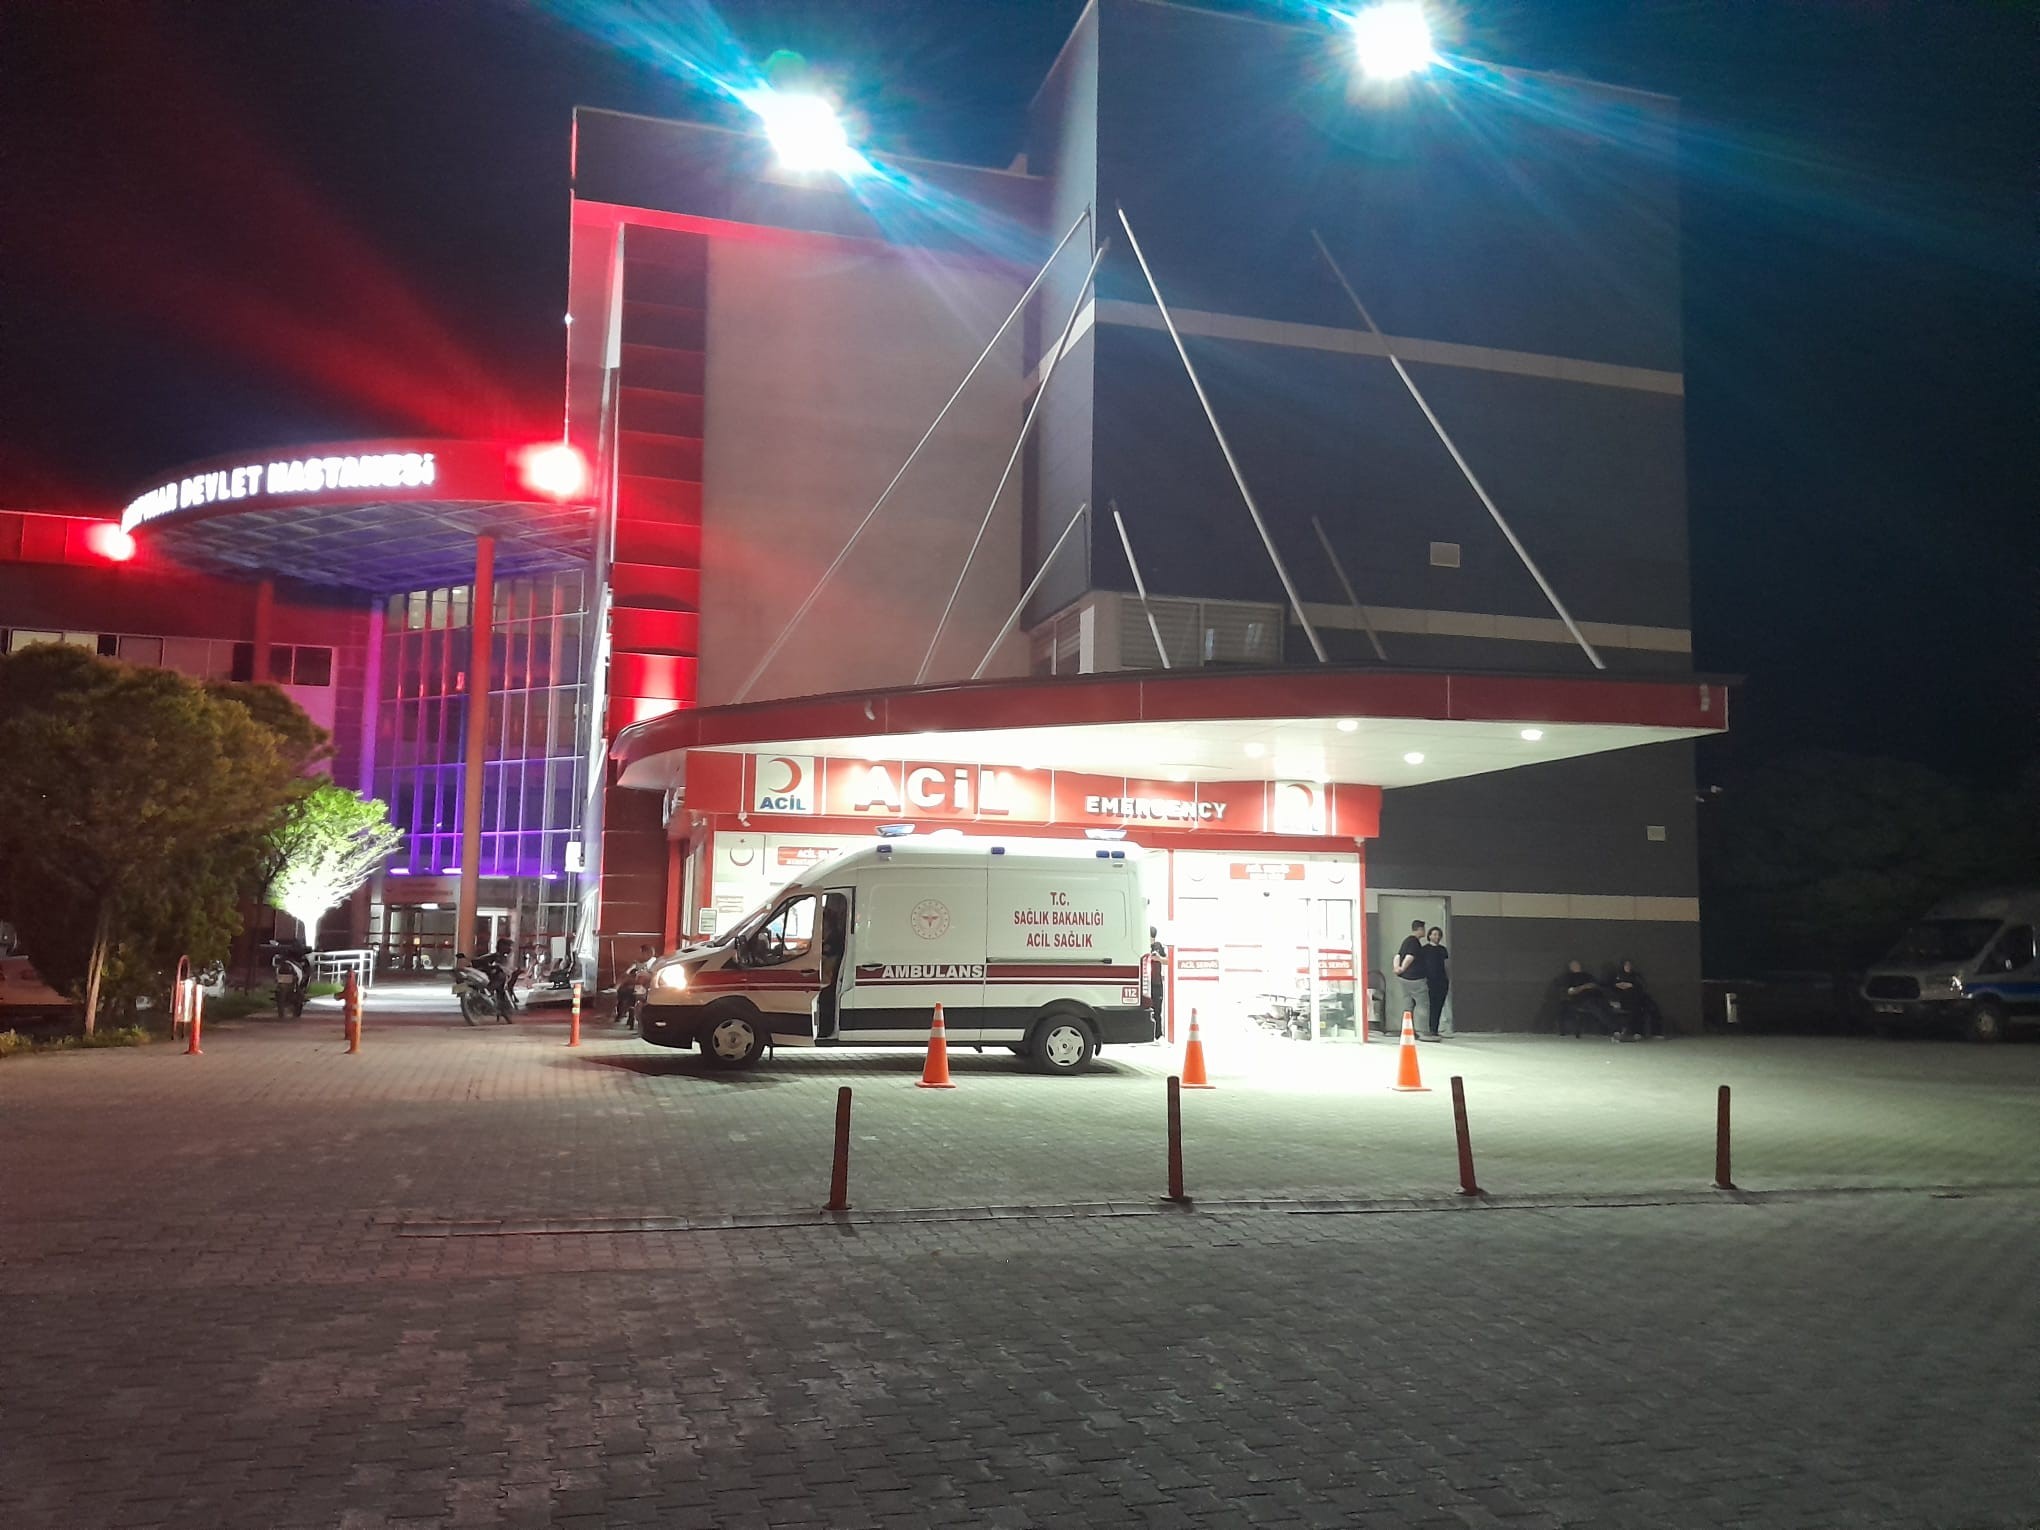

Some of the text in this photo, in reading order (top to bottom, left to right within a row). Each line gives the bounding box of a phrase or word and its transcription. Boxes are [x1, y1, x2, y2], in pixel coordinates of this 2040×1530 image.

[180, 465, 263, 509] DEVLET
[759, 794, 806, 811] ACİL
[1086, 796, 1227, 821] EMERGENCY
[1050, 892, 1070, 906] T.C.
[1014, 908, 1104, 926] SAĞLIK BAKANLIĞI
[1027, 930, 1093, 948] ACİL SAĞLIK
[882, 964, 983, 979] AMBULANS
[1124, 987, 1137, 998] 112
